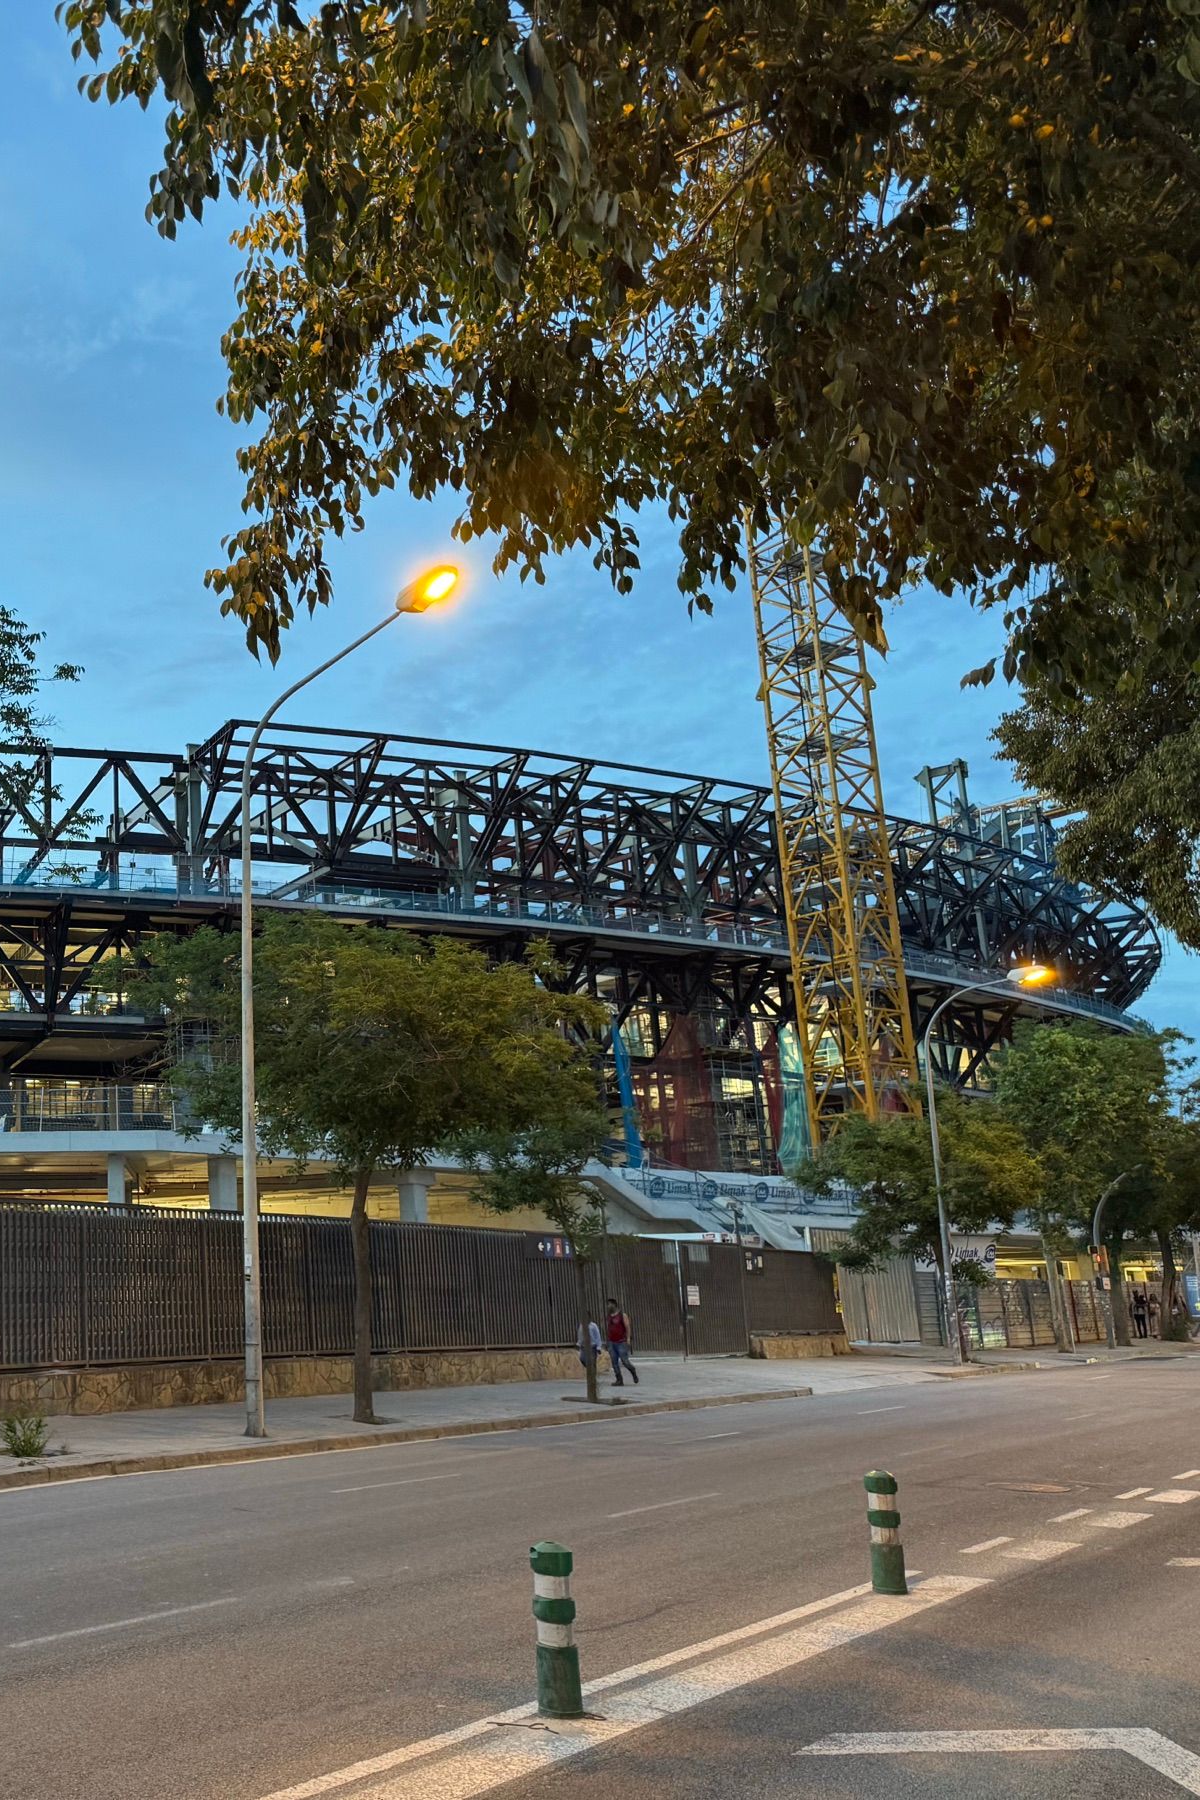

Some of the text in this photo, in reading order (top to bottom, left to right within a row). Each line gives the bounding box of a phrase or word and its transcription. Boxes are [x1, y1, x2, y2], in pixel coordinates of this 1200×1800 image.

[667, 1182, 692, 1195] Limak
[771, 1186, 796, 1199] Limak
[955, 1247, 979, 1259] Limak
